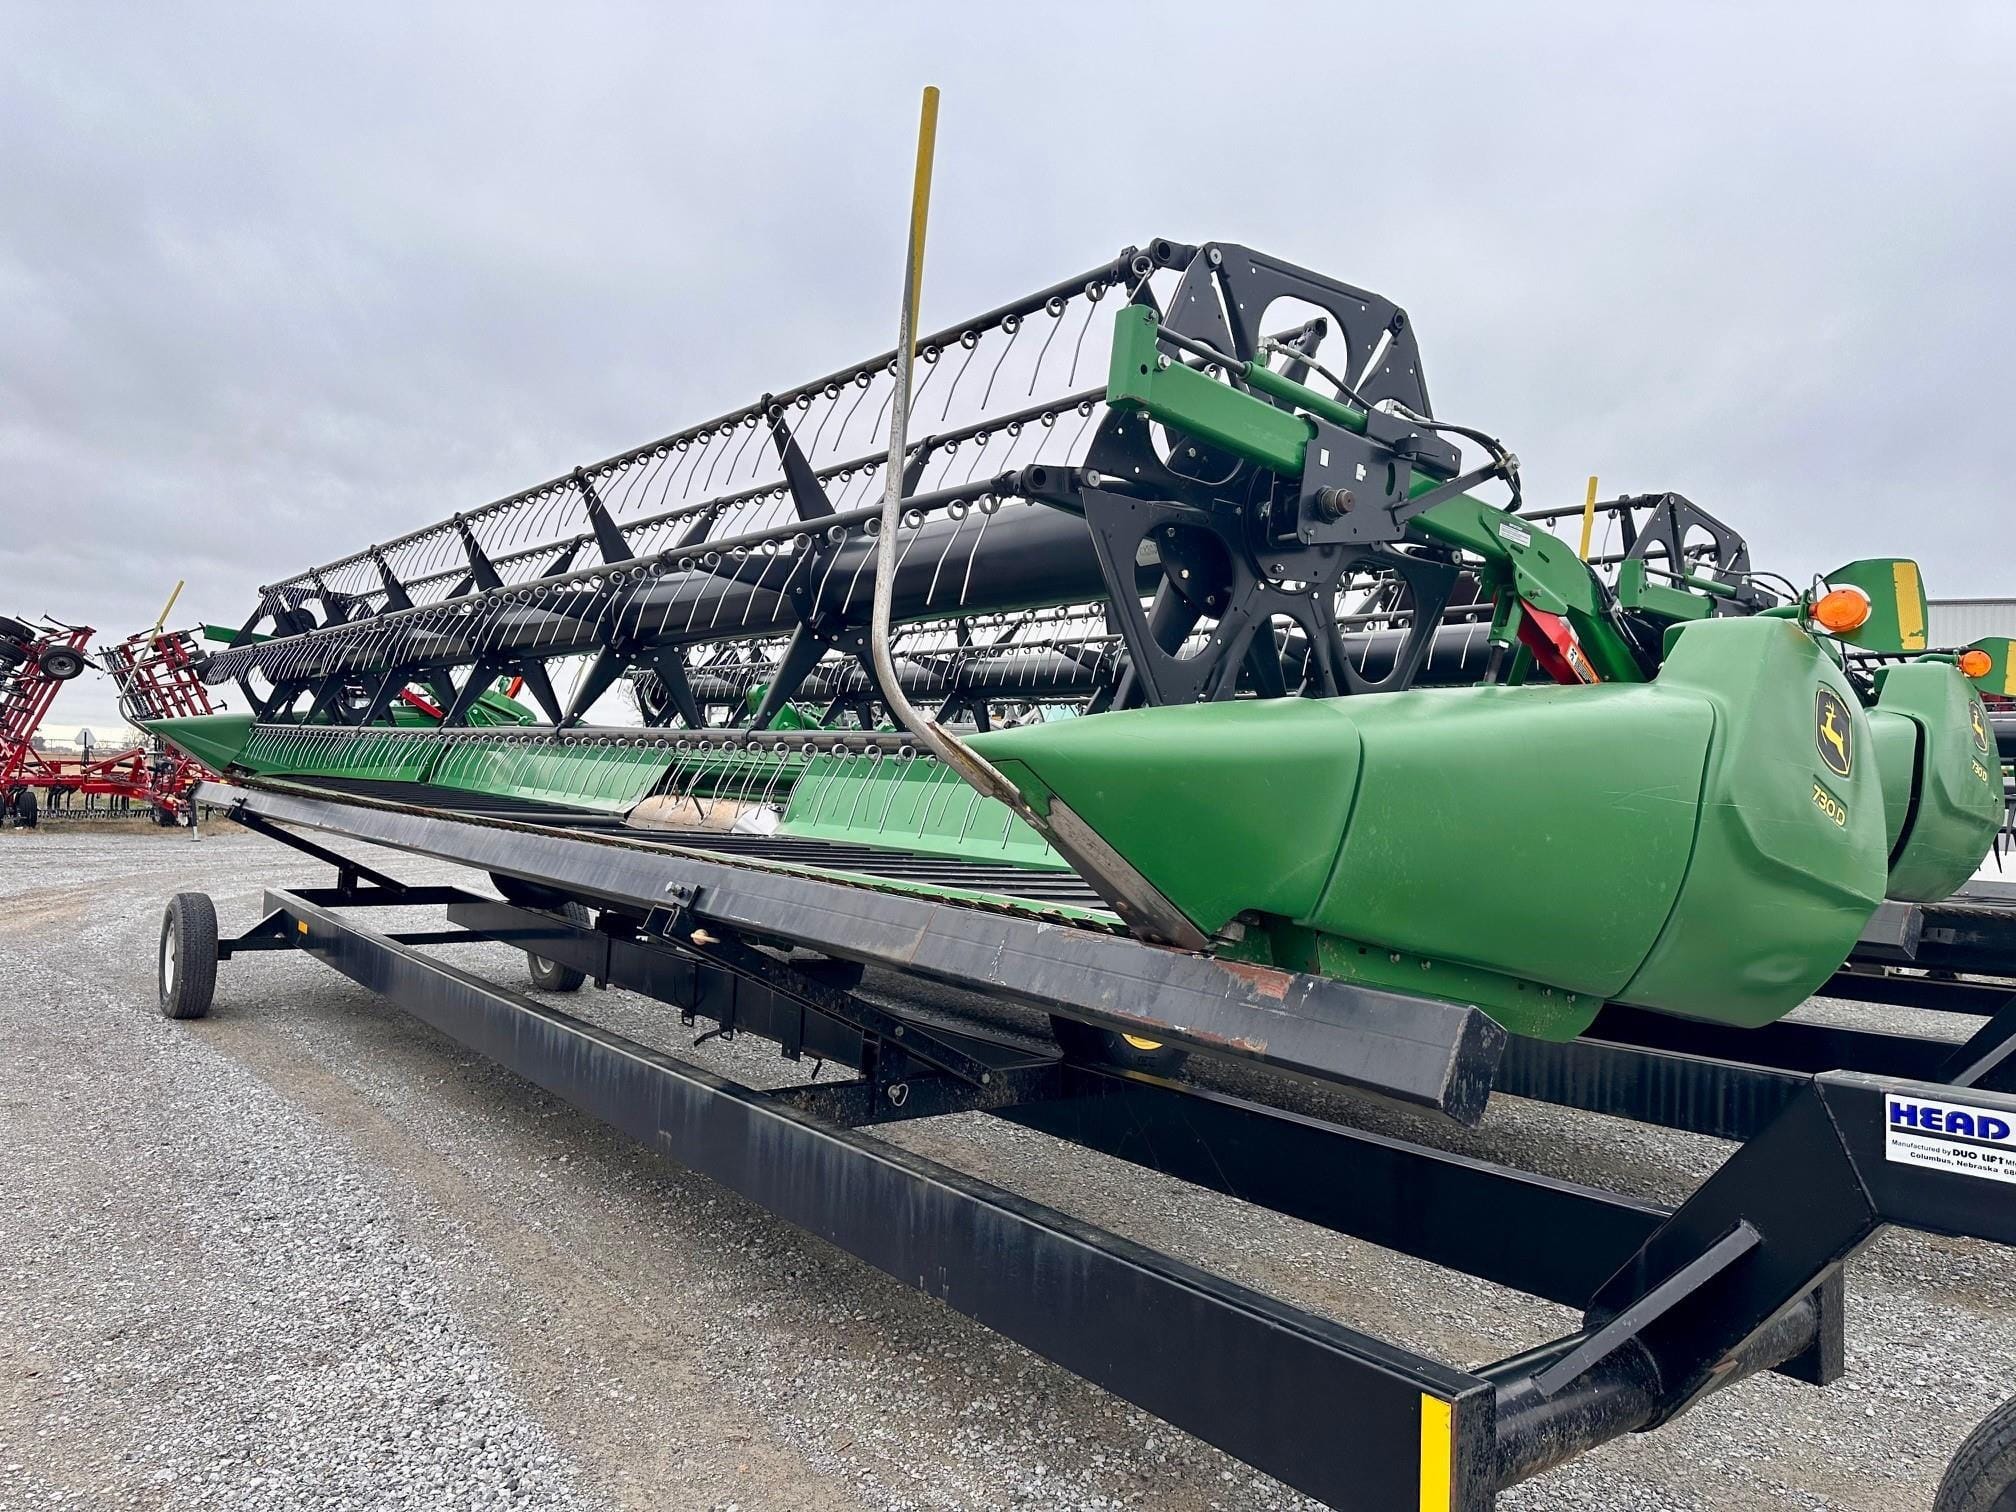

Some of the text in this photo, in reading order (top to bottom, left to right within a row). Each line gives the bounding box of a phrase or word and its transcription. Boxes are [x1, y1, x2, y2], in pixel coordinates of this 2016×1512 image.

[1811, 783, 1846, 826] 730D
[1889, 1101, 2011, 1140] HEAD
[1891, 1139, 1940, 1153] Manufactured
[1942, 1148, 1952, 1156] by
[1952, 1149, 1977, 1159] DUO
[1910, 1152, 2016, 1176] Columbus, Nebraska 68
